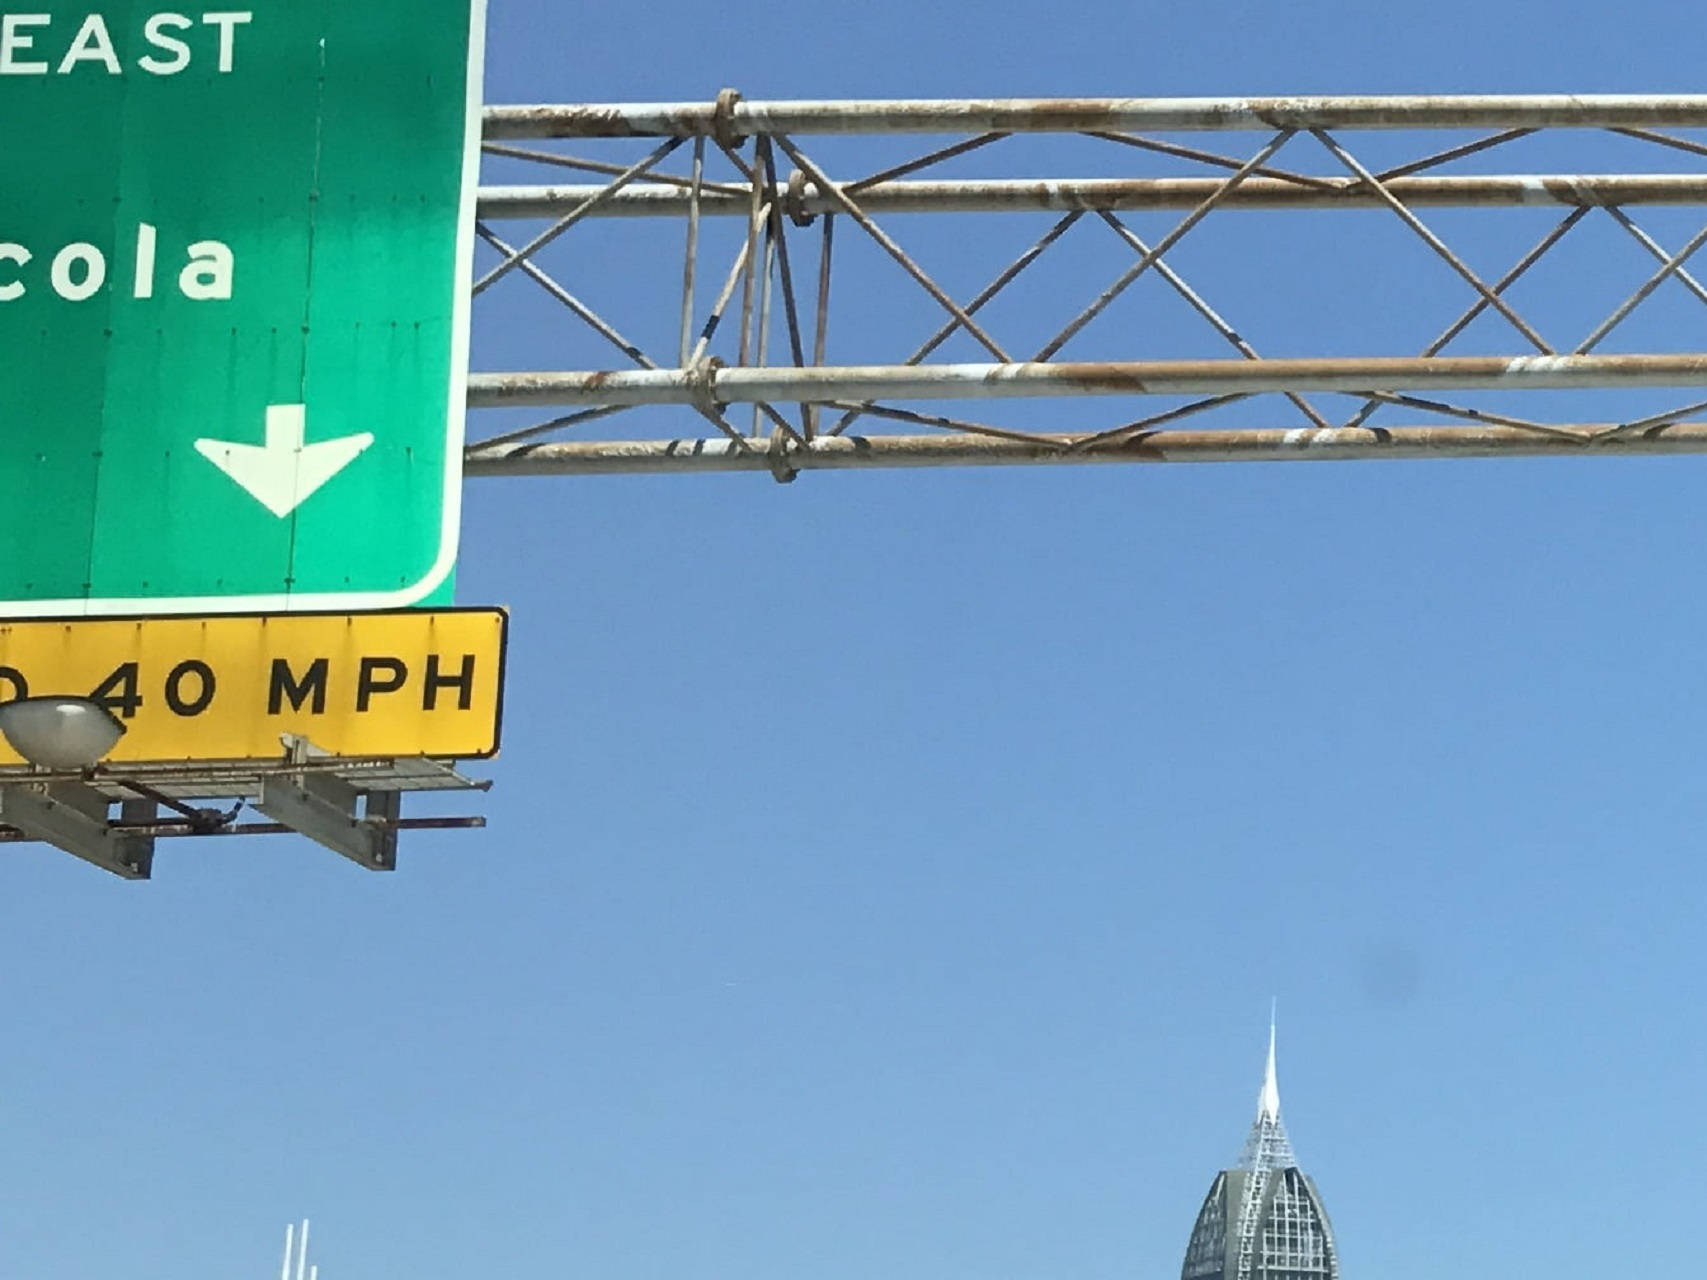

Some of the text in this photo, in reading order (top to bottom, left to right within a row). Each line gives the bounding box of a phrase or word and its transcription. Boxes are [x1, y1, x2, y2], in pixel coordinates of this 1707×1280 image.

[0, 11, 252, 75] EAST
[0, 221, 235, 301] cola
[88, 659, 216, 719] 40
[267, 653, 476, 715] MPH
